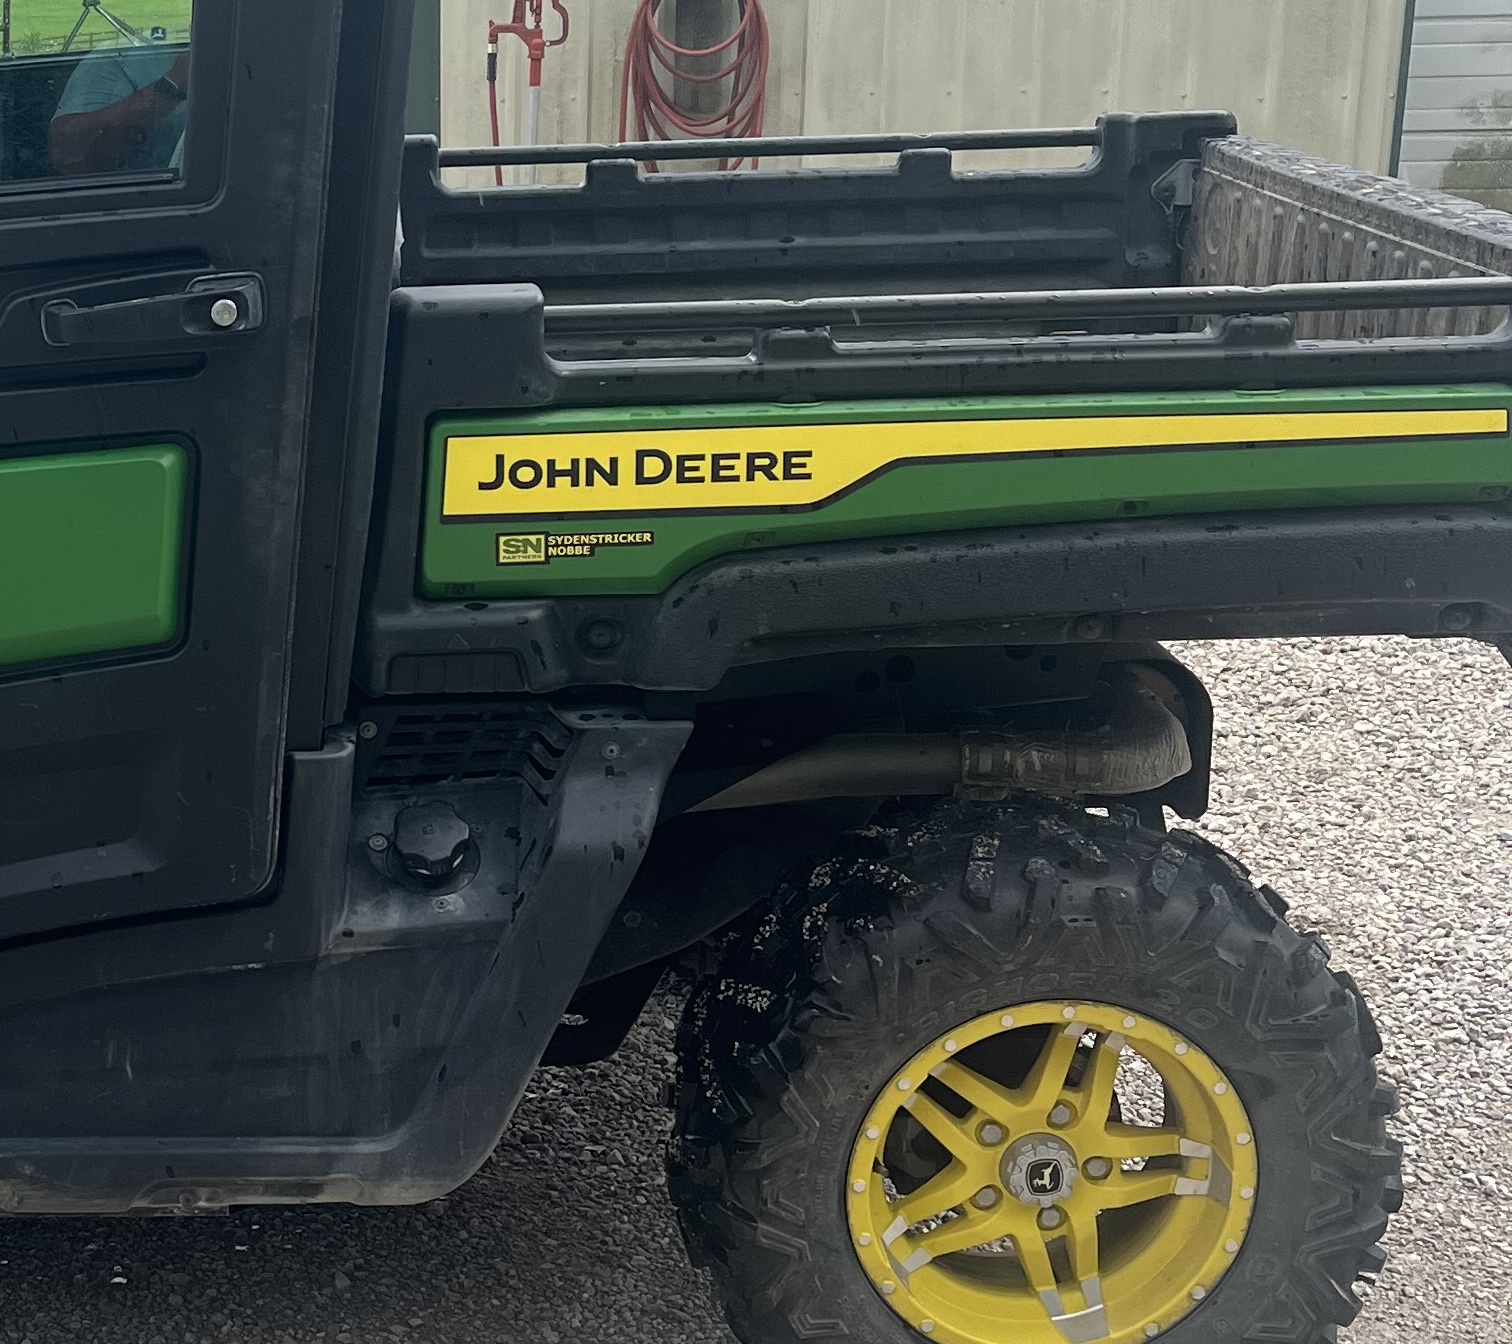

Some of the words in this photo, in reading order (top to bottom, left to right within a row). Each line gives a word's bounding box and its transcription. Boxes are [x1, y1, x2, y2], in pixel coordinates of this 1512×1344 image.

[478, 453, 619, 491] JOHN
[634, 448, 813, 486] DEERE
[547, 532, 652, 546] SYDENSTRICKER
[547, 545, 591, 556] NOBBE
